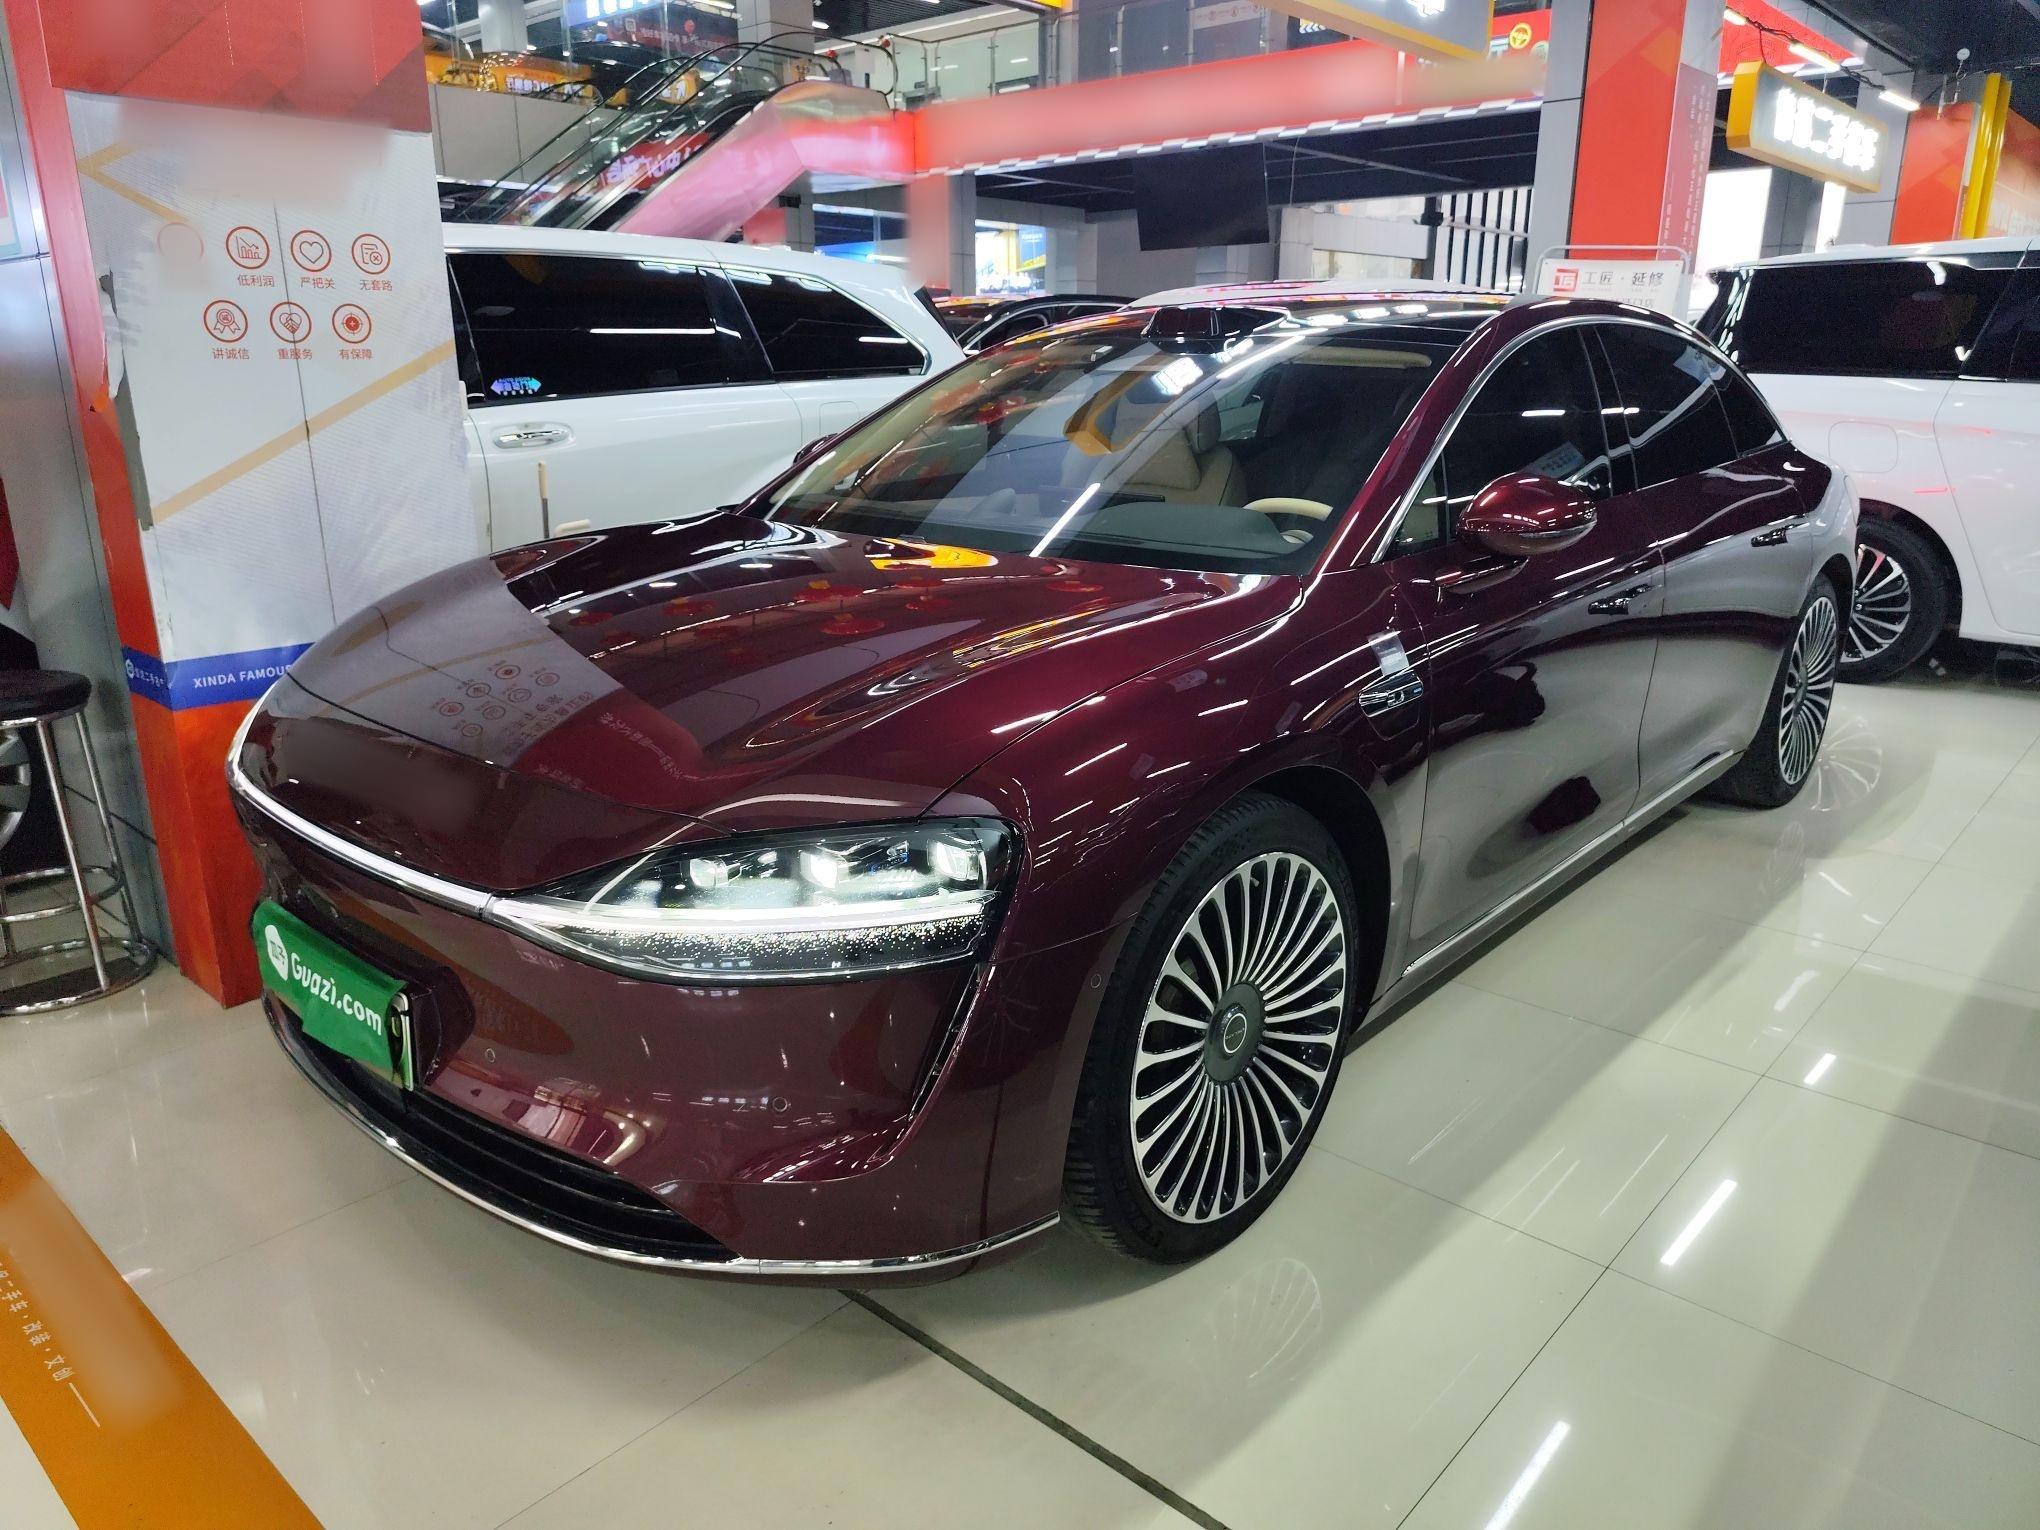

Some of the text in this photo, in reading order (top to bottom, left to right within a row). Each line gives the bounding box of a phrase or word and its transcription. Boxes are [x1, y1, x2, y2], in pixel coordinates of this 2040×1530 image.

[237, 274, 275, 287] 低利润
[300, 277, 336, 290] 严把关
[359, 279, 393, 292] 无套路
[212, 348, 250, 360] 讲诚信
[277, 348, 313, 360] 重服务
[339, 348, 373, 360] 有保障
[193, 674, 236, 688] XINDA
